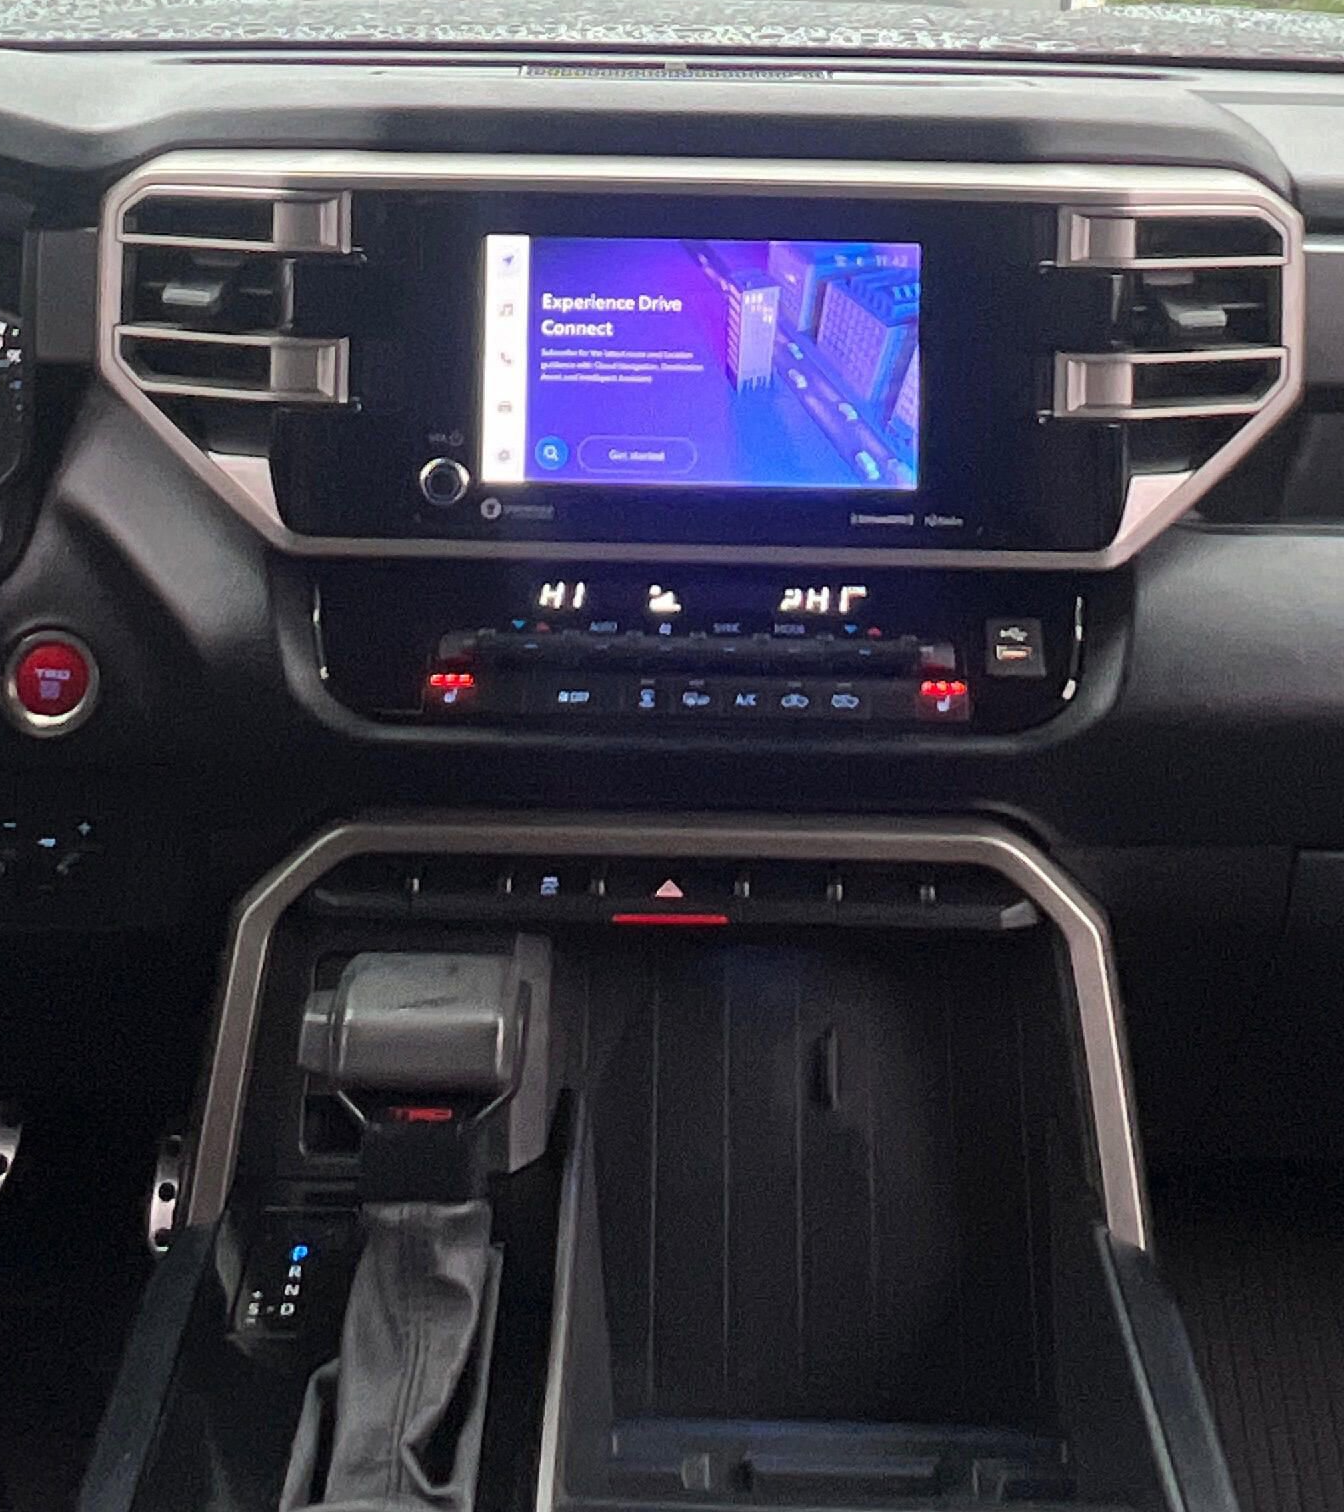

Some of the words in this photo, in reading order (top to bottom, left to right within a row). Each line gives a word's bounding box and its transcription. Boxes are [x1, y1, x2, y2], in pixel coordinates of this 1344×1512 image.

[541, 292, 636, 313] Experience
[638, 294, 683, 312] Drive
[540, 319, 614, 337] Connect
[538, 581, 586, 609] HI
[292, 1245, 308, 1262] P
